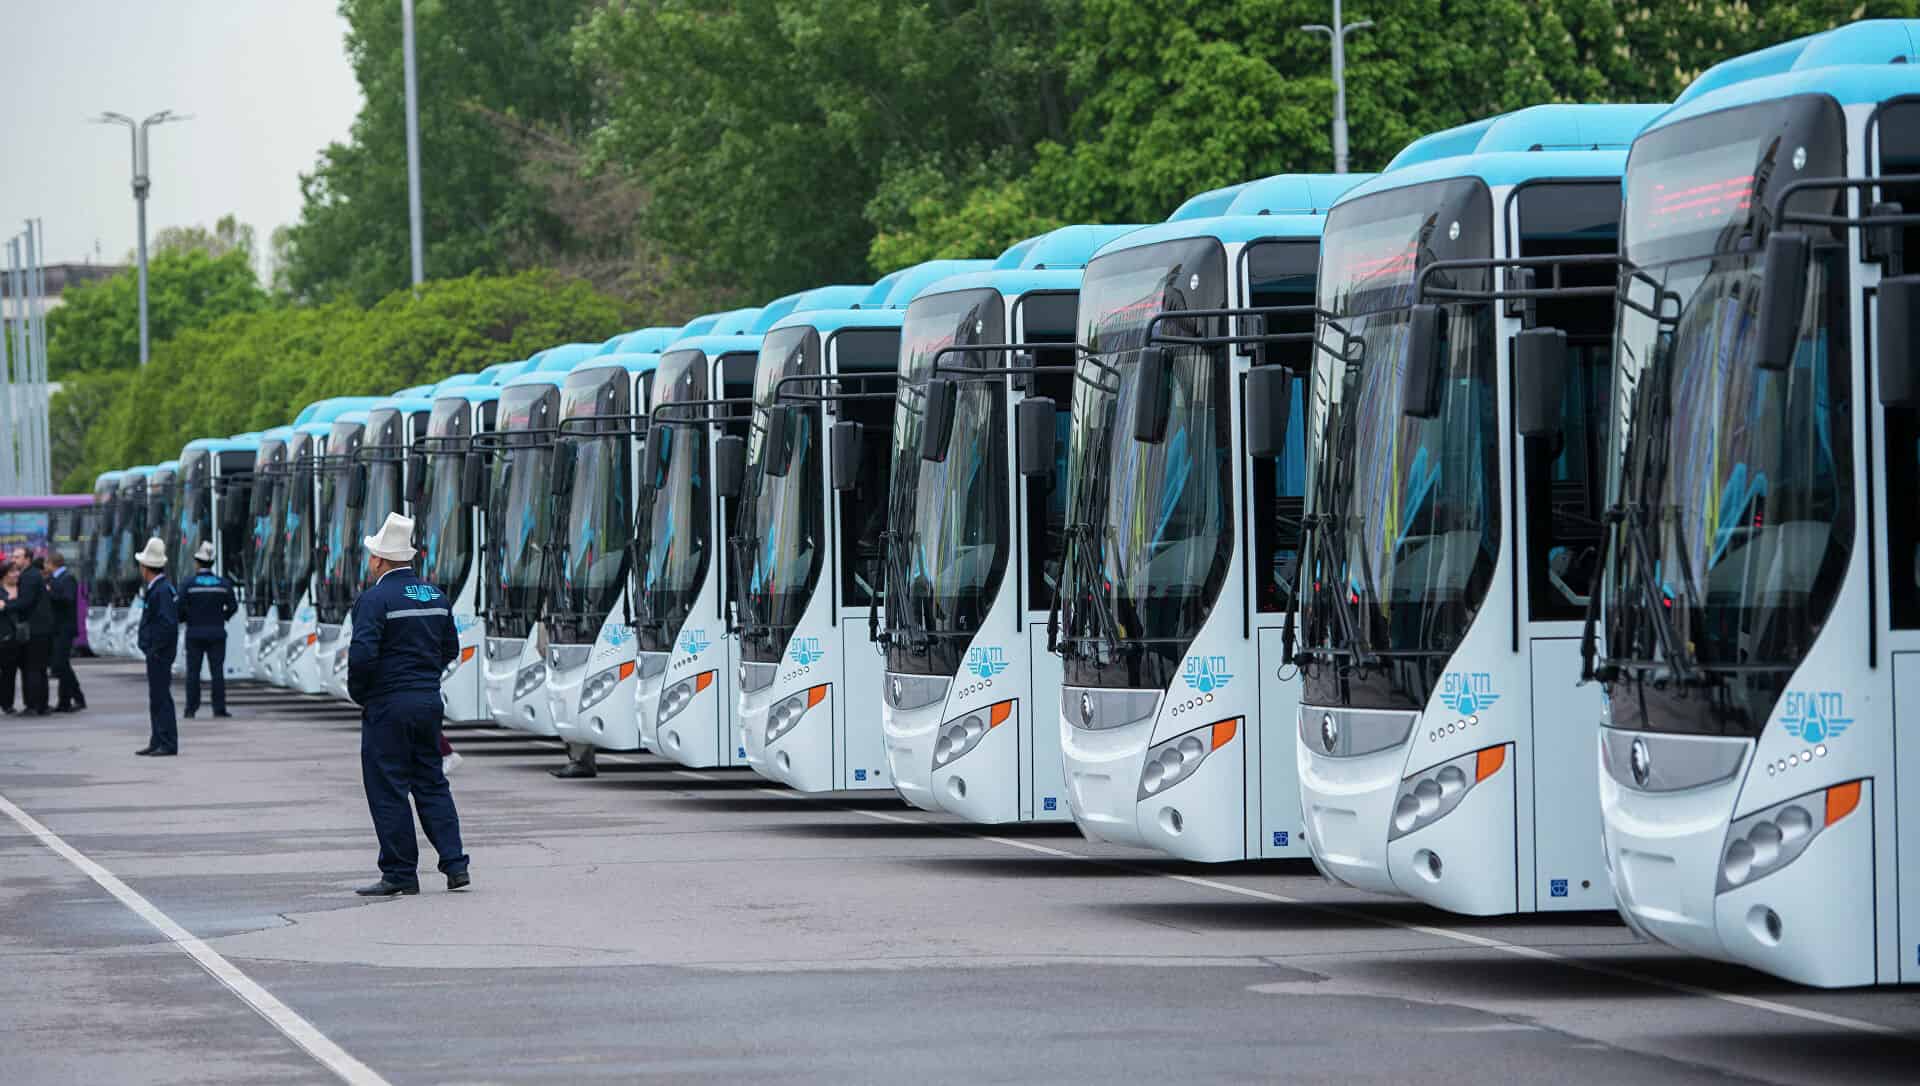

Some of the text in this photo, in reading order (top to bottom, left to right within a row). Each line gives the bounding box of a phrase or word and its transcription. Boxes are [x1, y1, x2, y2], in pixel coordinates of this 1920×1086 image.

[971, 647, 1002, 673] БПАТП
[1187, 656, 1226, 686] БПАТП
[1444, 672, 1491, 709] БПАТП
[1786, 692, 1843, 733] БПАТП
